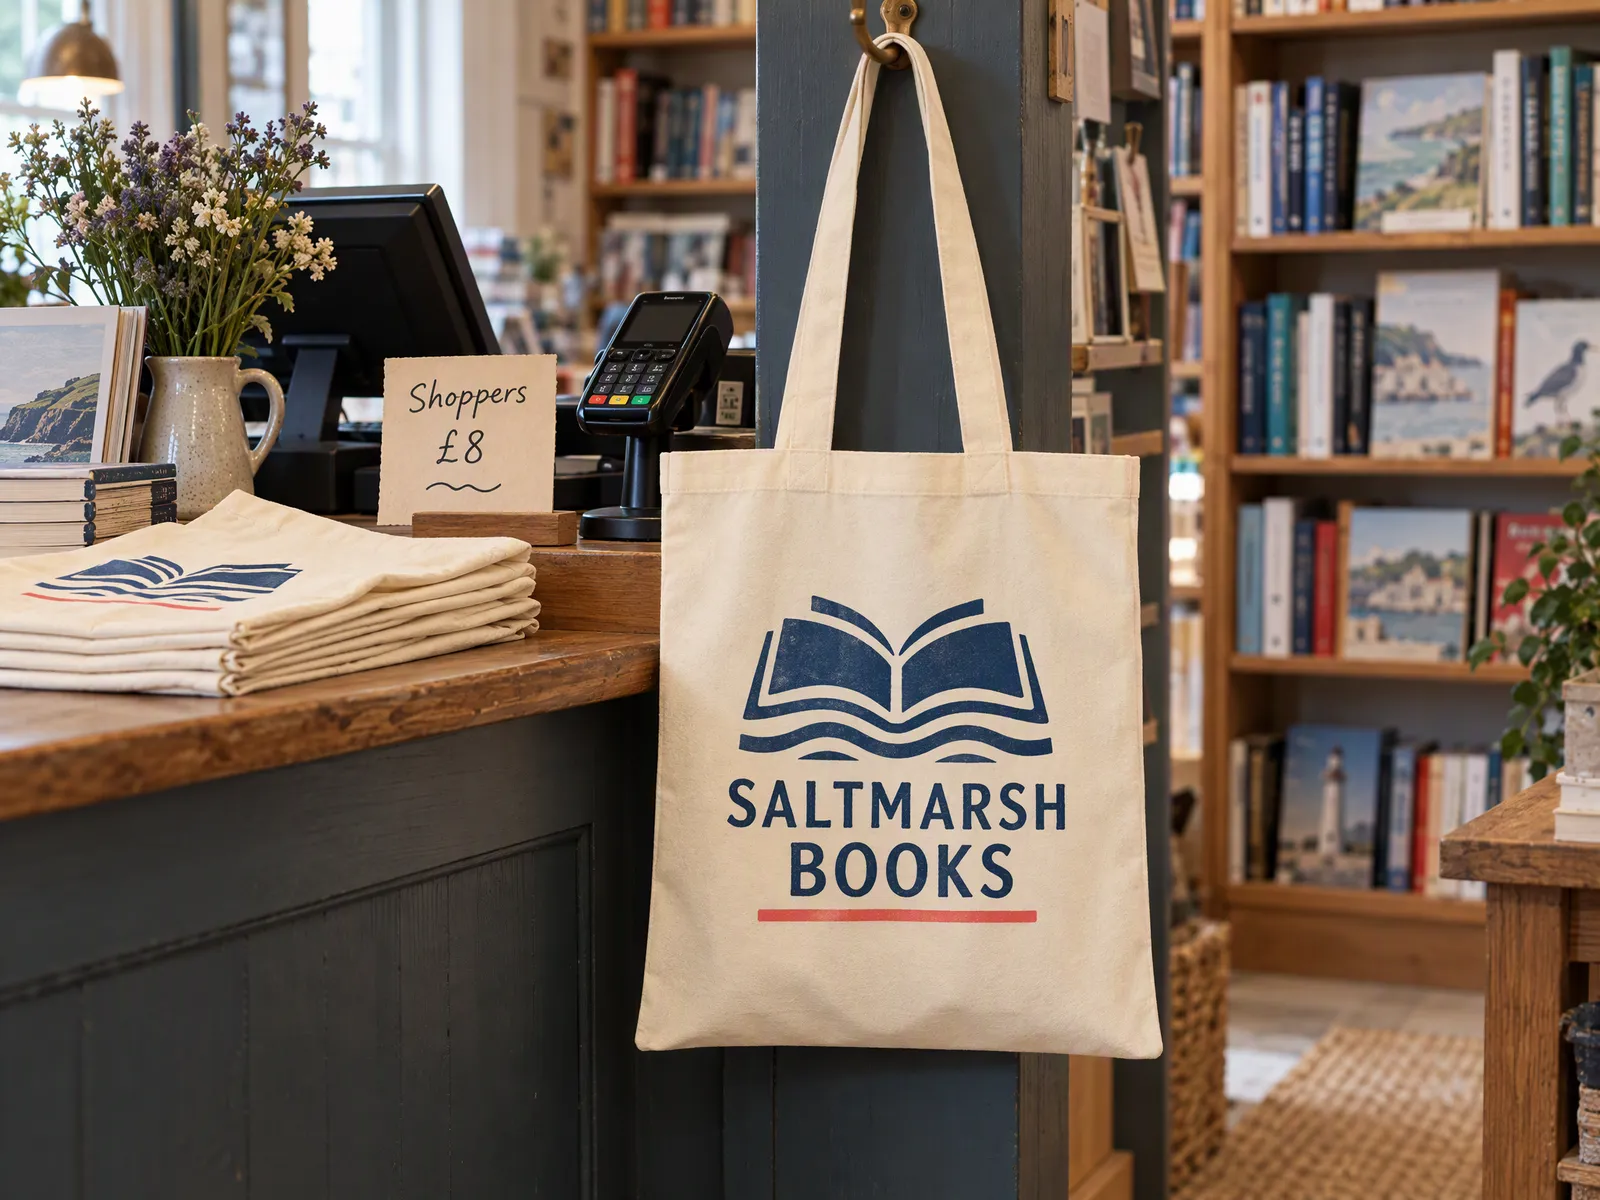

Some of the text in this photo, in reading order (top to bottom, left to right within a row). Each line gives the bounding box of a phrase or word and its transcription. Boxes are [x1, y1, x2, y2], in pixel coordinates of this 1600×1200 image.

[409, 378, 527, 420] Shoppers
[435, 428, 485, 465] £8
[726, 777, 1066, 831] SALTMARSH
[789, 841, 1014, 900] BOOKS
